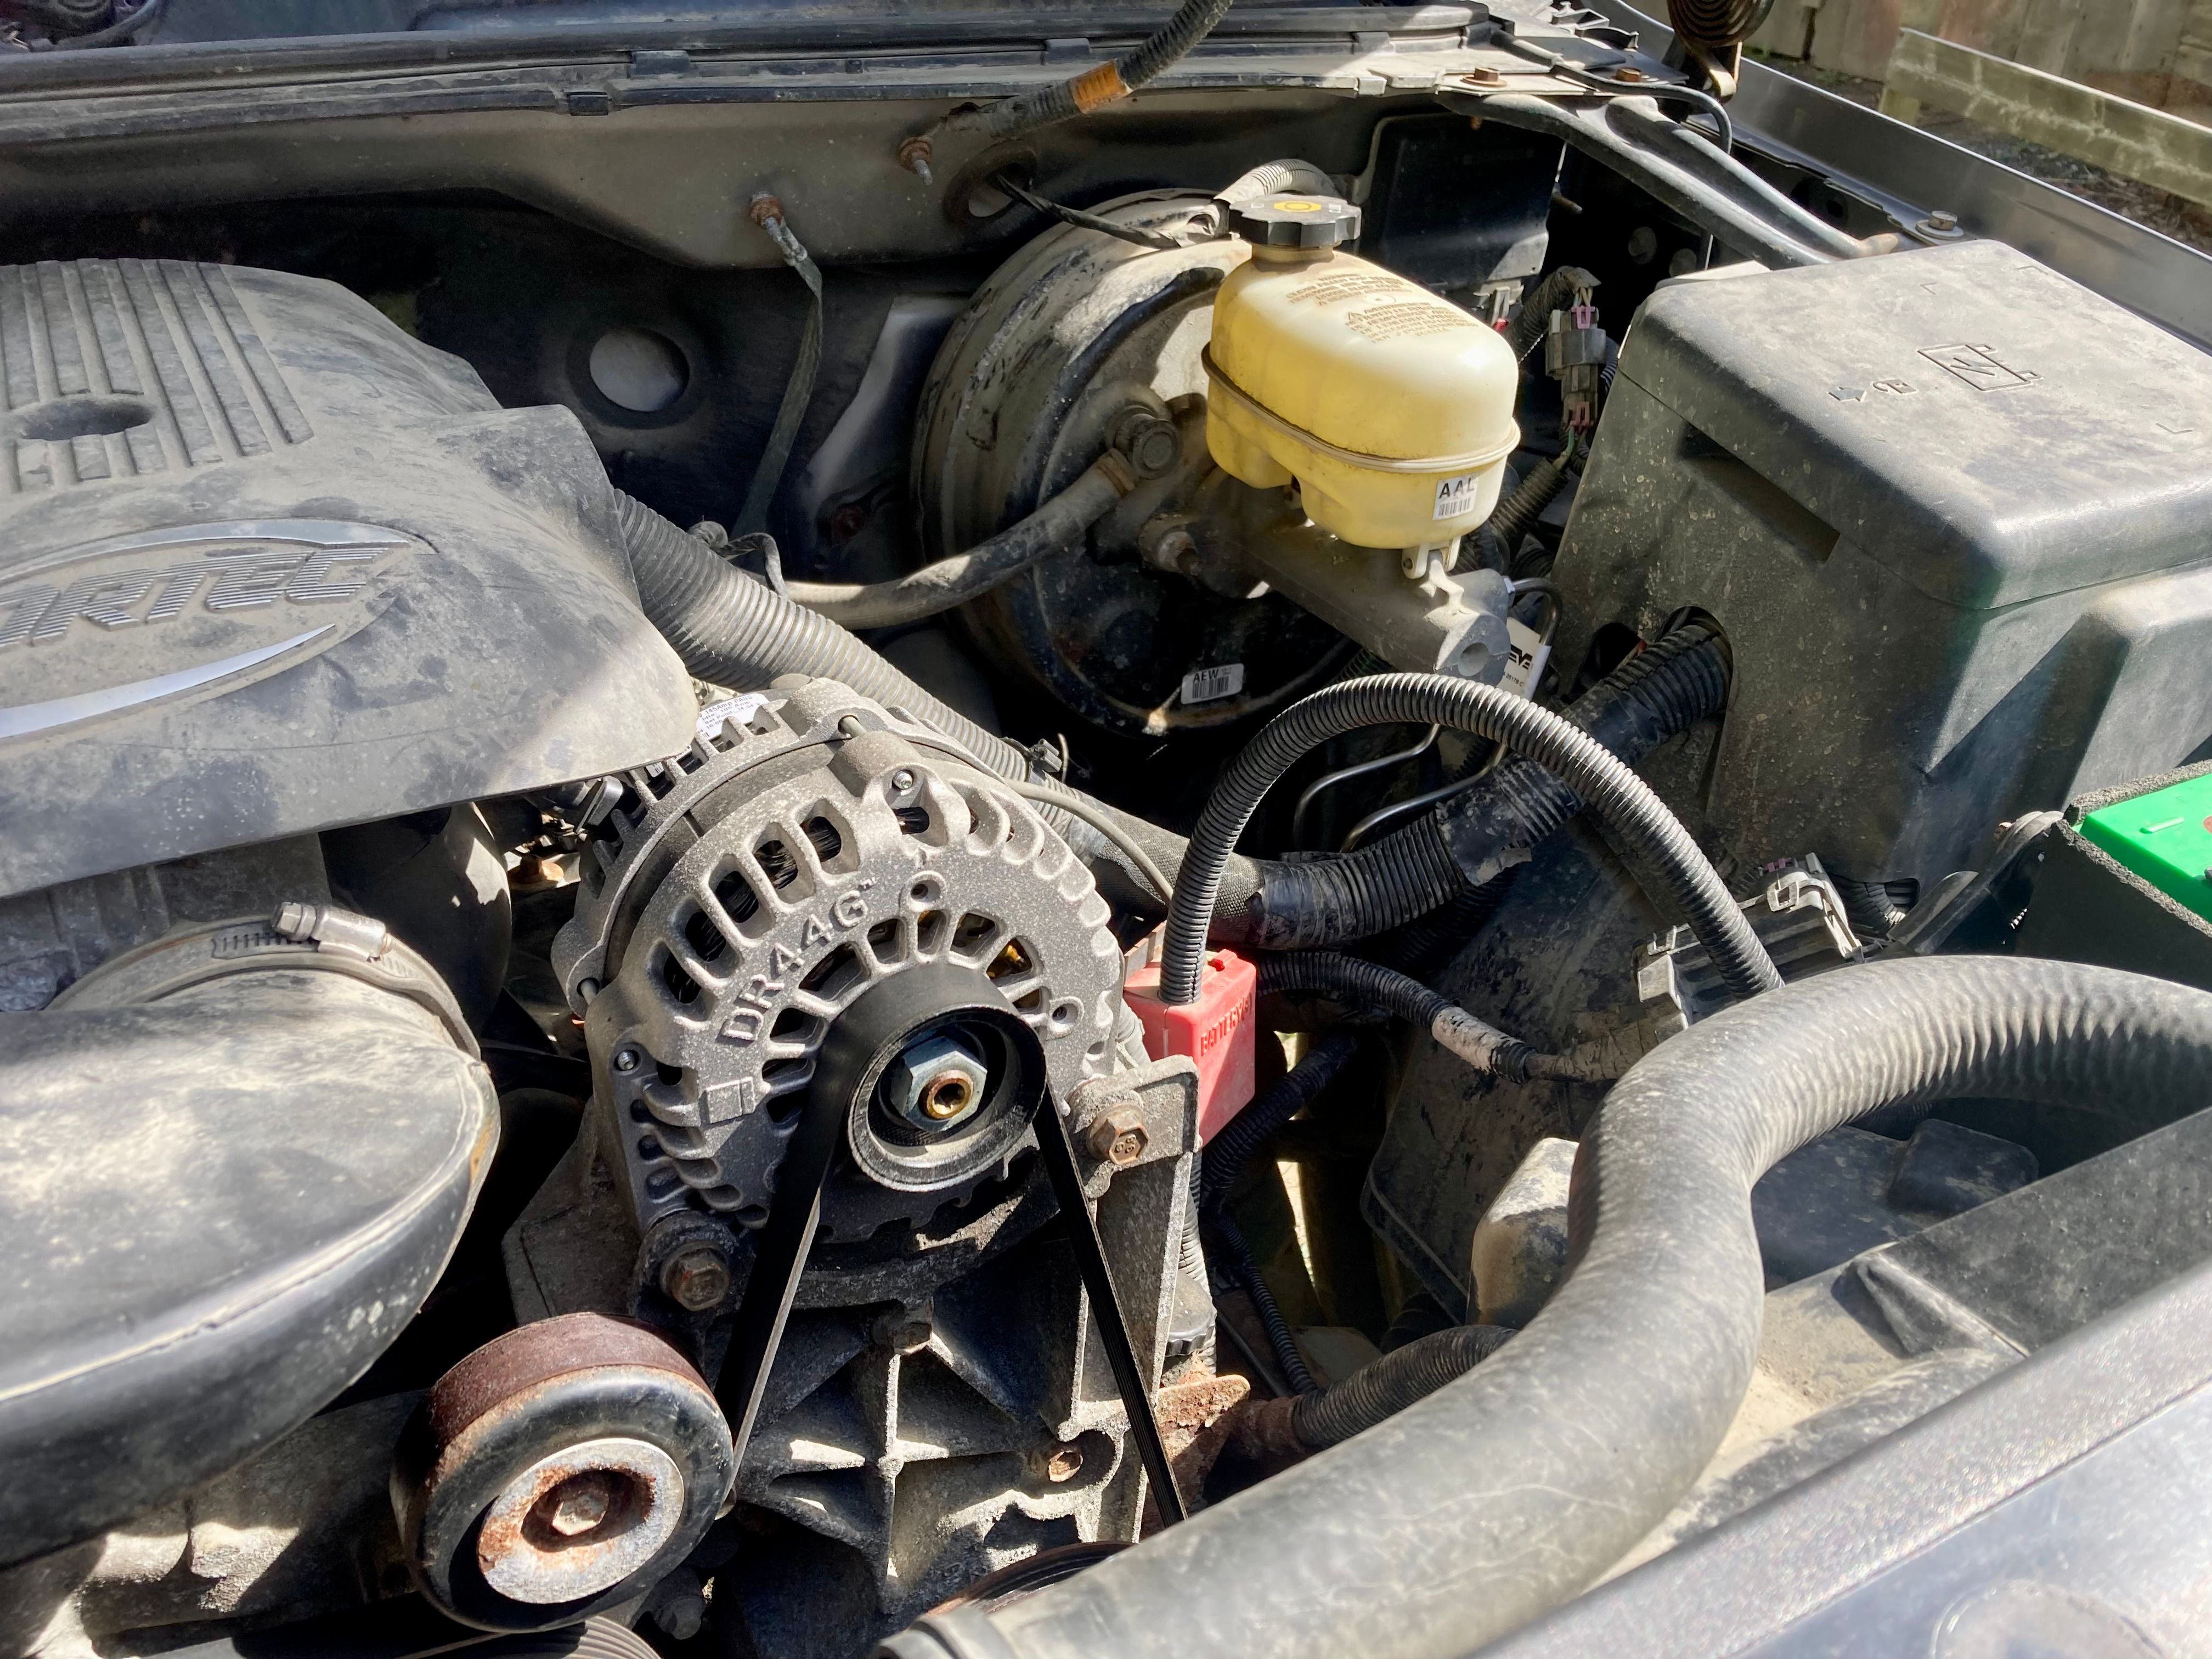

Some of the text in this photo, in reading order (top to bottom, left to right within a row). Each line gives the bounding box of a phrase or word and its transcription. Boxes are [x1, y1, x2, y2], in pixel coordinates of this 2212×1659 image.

[1438, 477, 1475, 499] AAL
[1193, 668, 1219, 683] AEW
[705, 701, 732, 714] 145Amp
